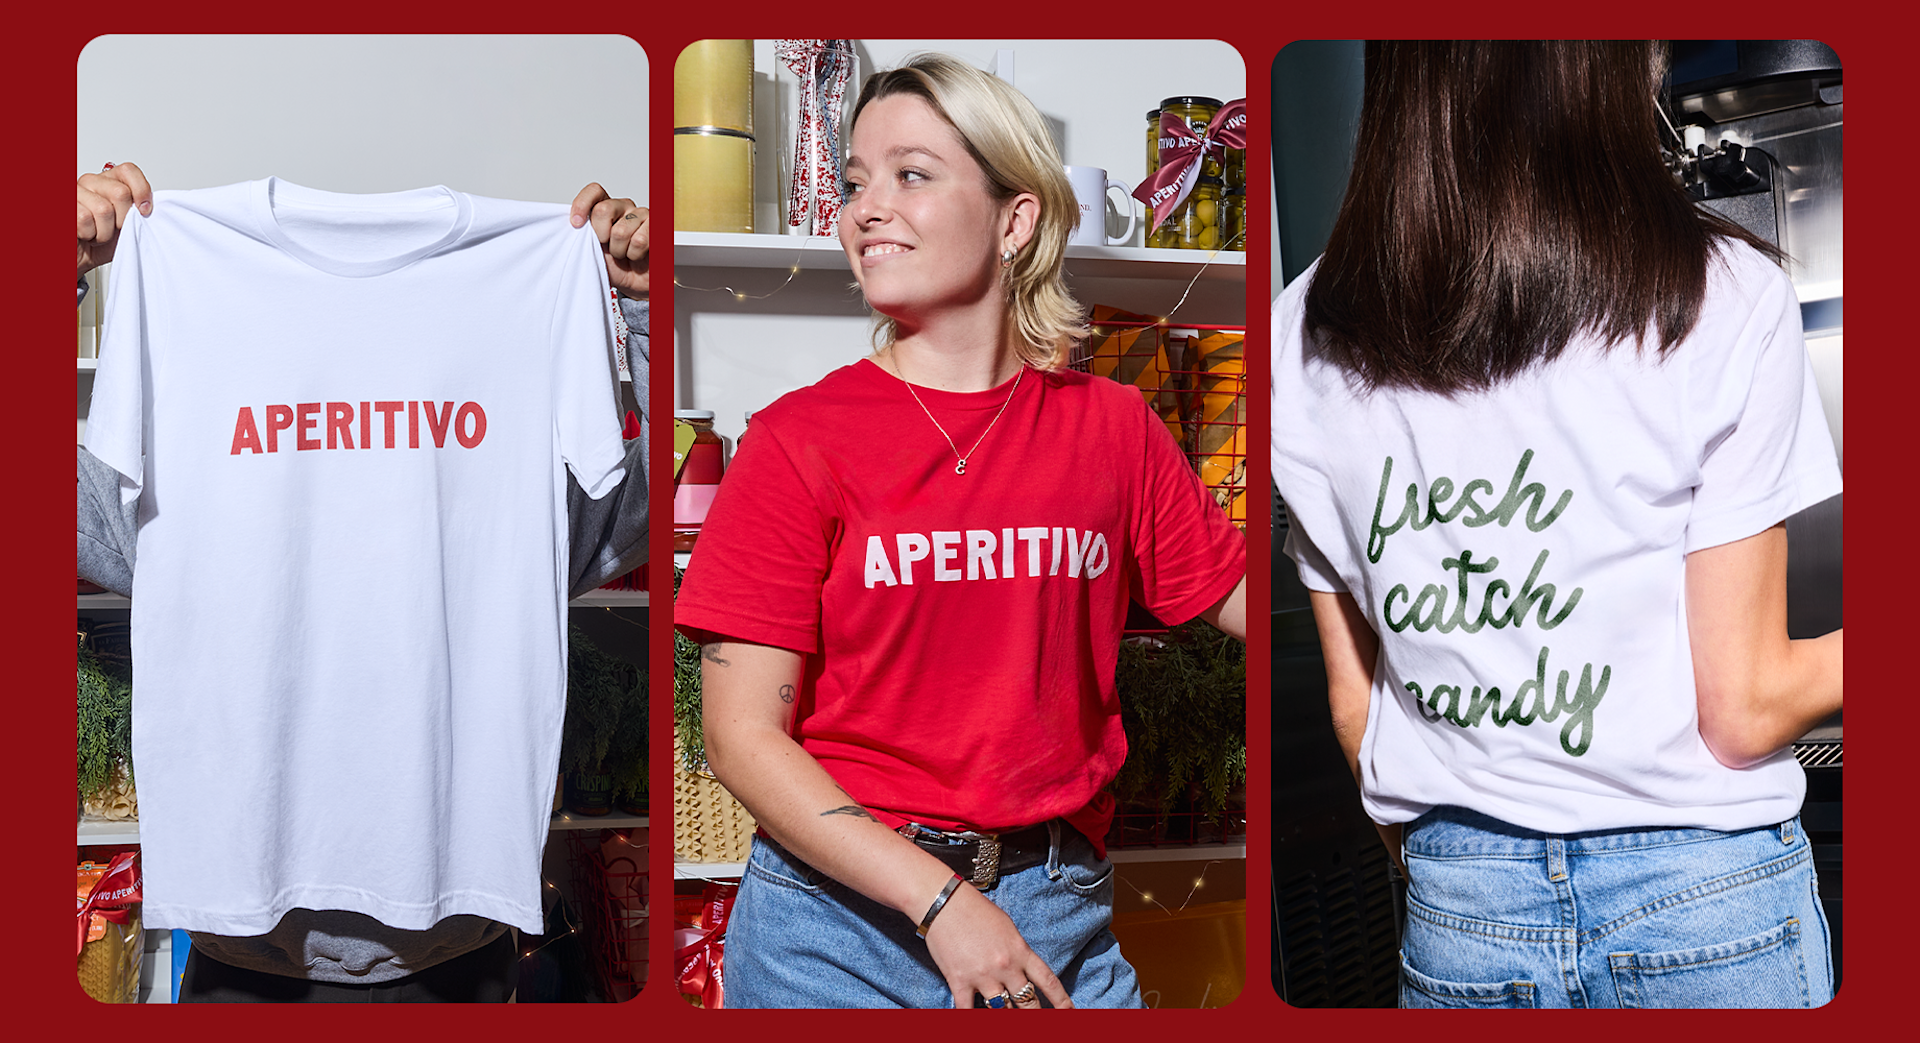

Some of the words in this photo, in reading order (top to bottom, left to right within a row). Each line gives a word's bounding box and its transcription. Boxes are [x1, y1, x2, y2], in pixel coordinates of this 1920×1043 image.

[230, 401, 487, 455] APERITIVO
[1367, 448, 1574, 564] fresh
[864, 527, 1109, 589] APERITIVO
[1384, 550, 1584, 634] catch
